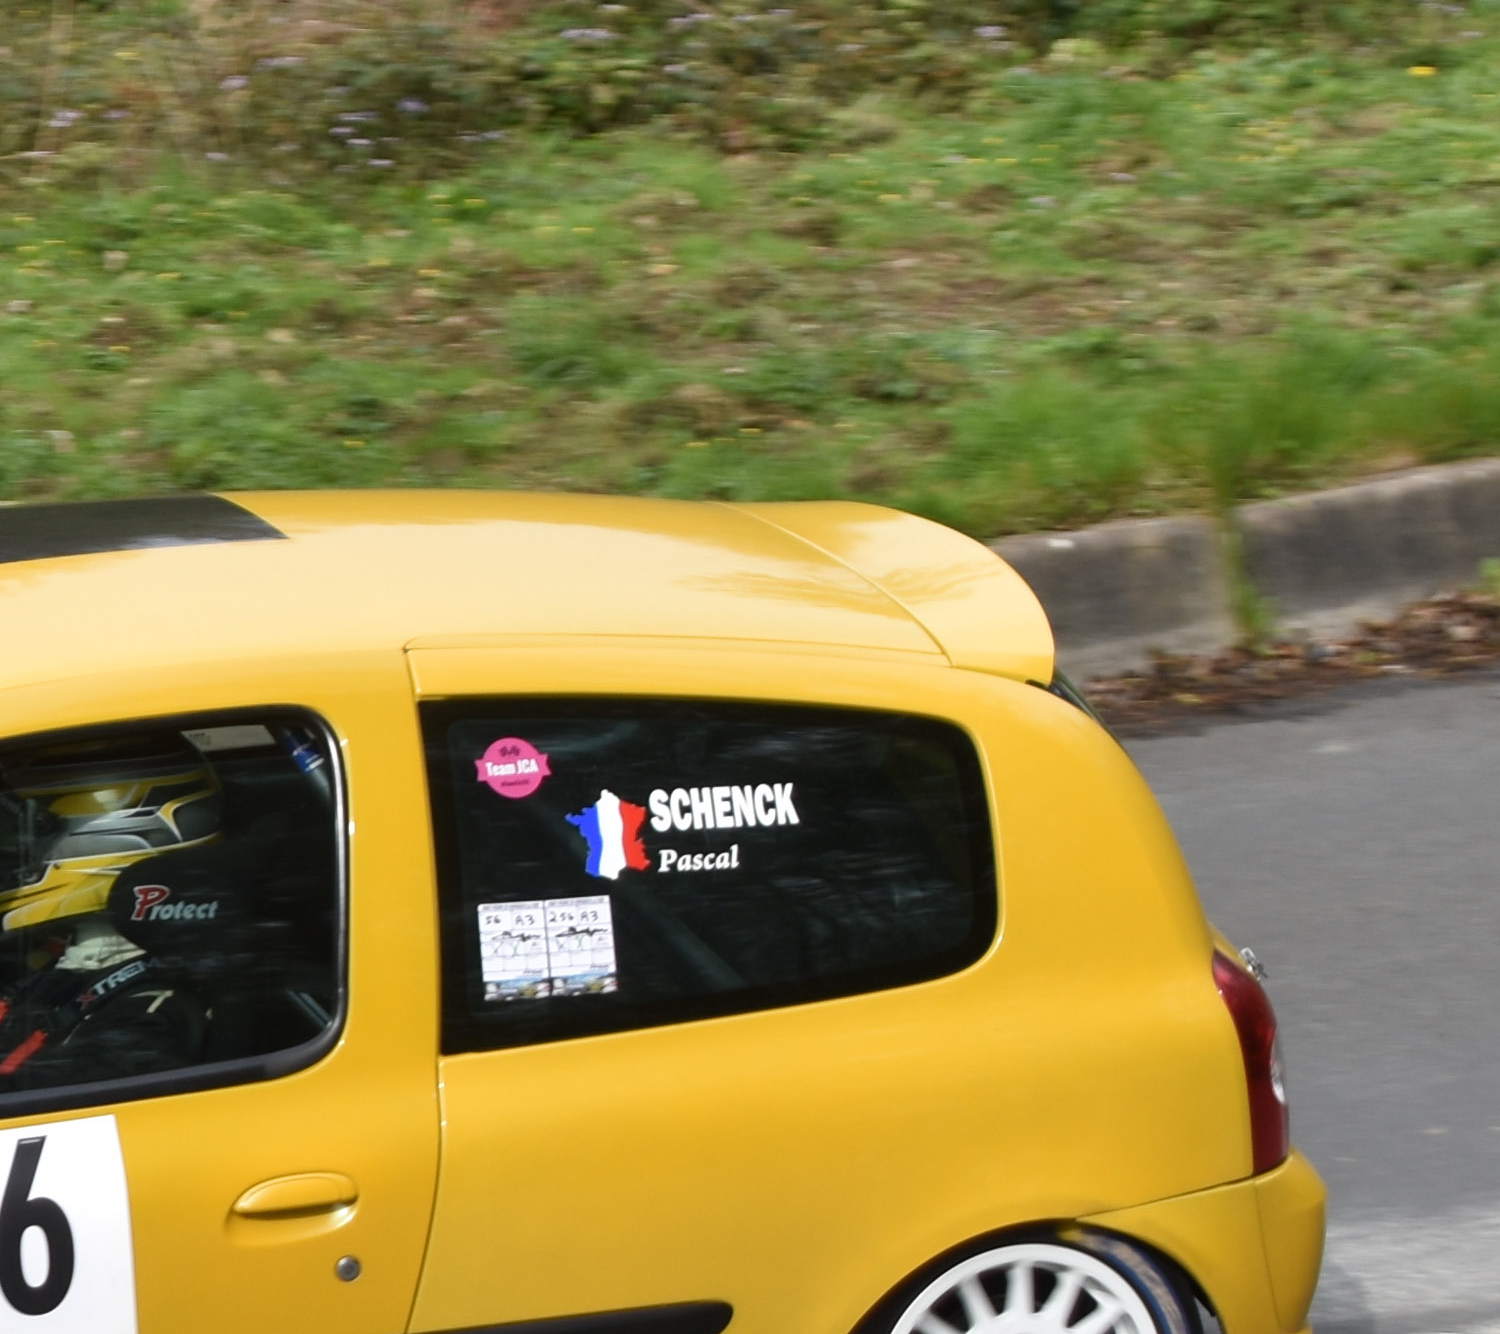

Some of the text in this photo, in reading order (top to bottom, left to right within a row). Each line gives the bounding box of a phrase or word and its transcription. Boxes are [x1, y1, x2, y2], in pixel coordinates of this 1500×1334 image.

[485, 758, 540, 777] Team JCA
[648, 782, 800, 833] SCHENCK
[657, 844, 740, 874] Pascal
[130, 884, 219, 921] Protect
